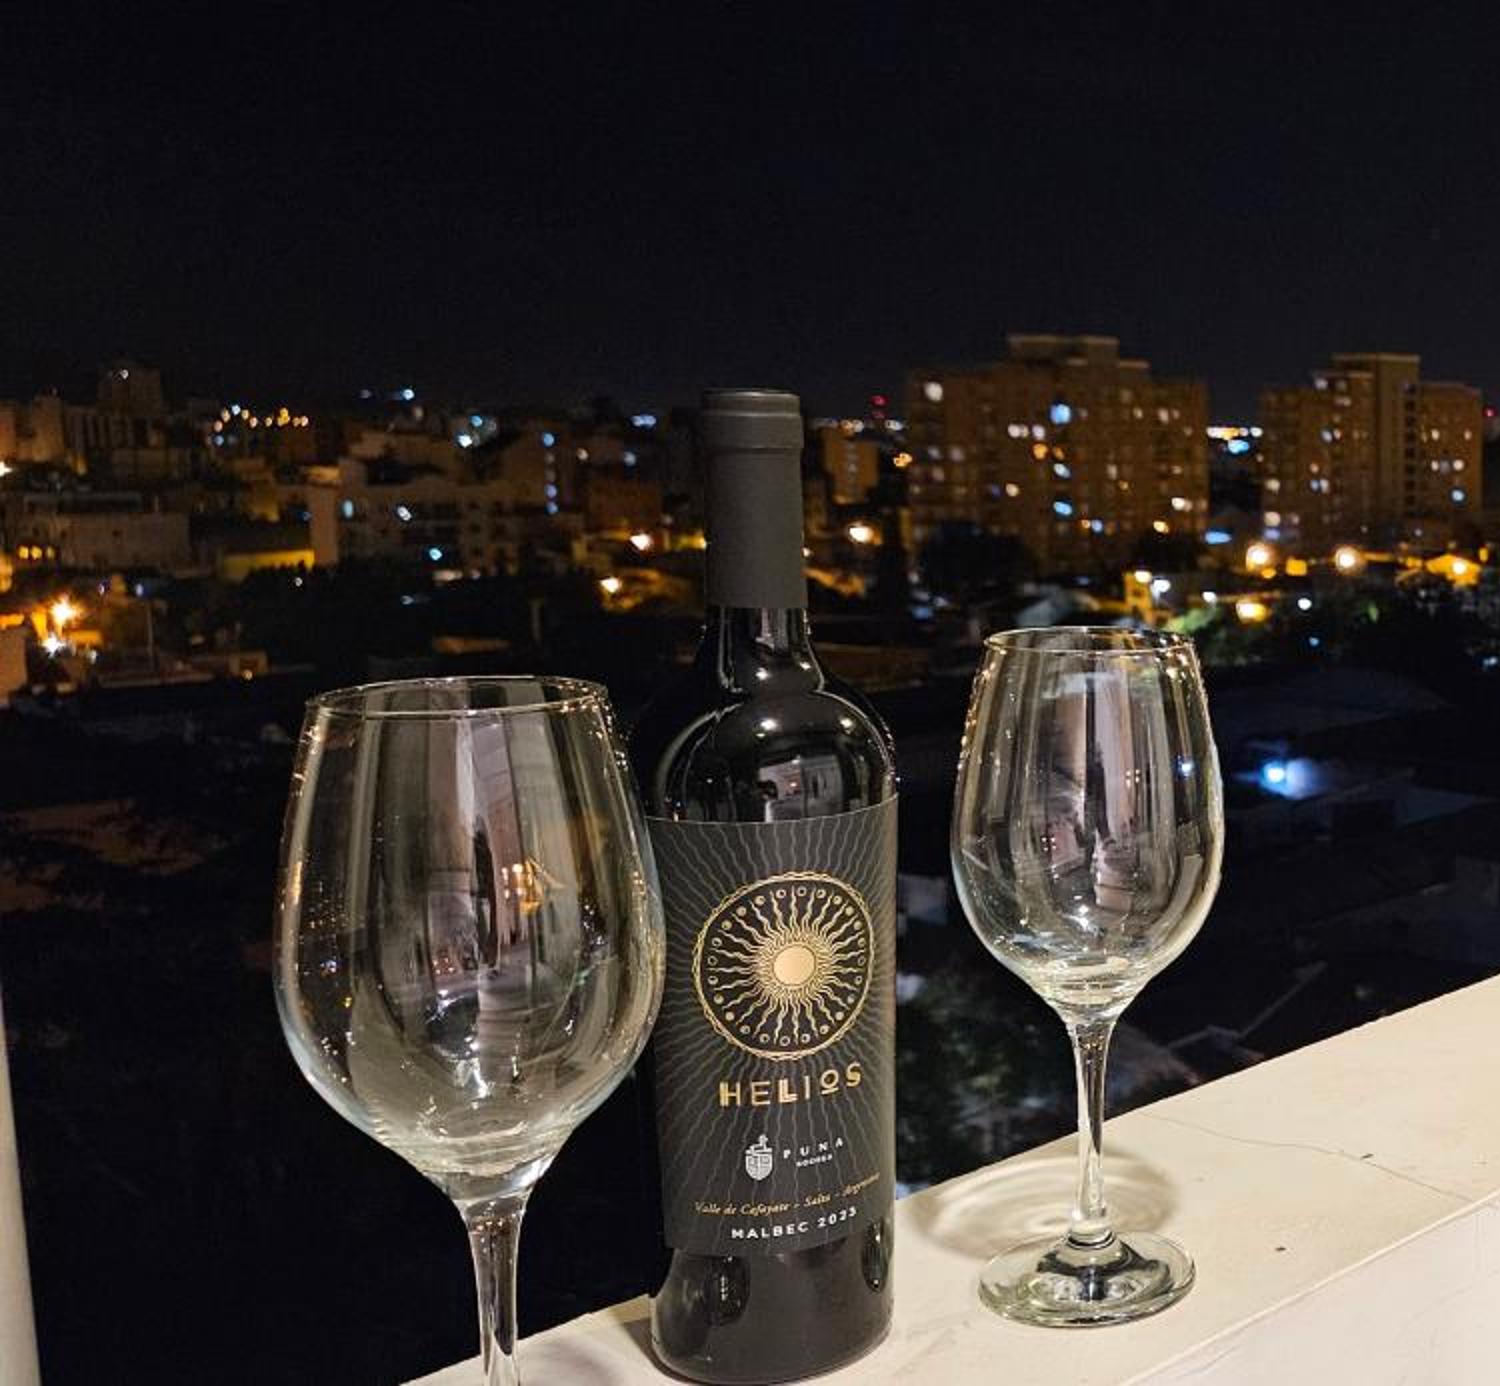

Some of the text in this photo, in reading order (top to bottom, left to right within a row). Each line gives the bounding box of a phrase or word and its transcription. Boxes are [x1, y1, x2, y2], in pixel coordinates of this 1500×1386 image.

[719, 1061, 862, 1106] HELIOS
[783, 1137, 843, 1159] PUNA
[731, 1221, 808, 1239] MALBEC
